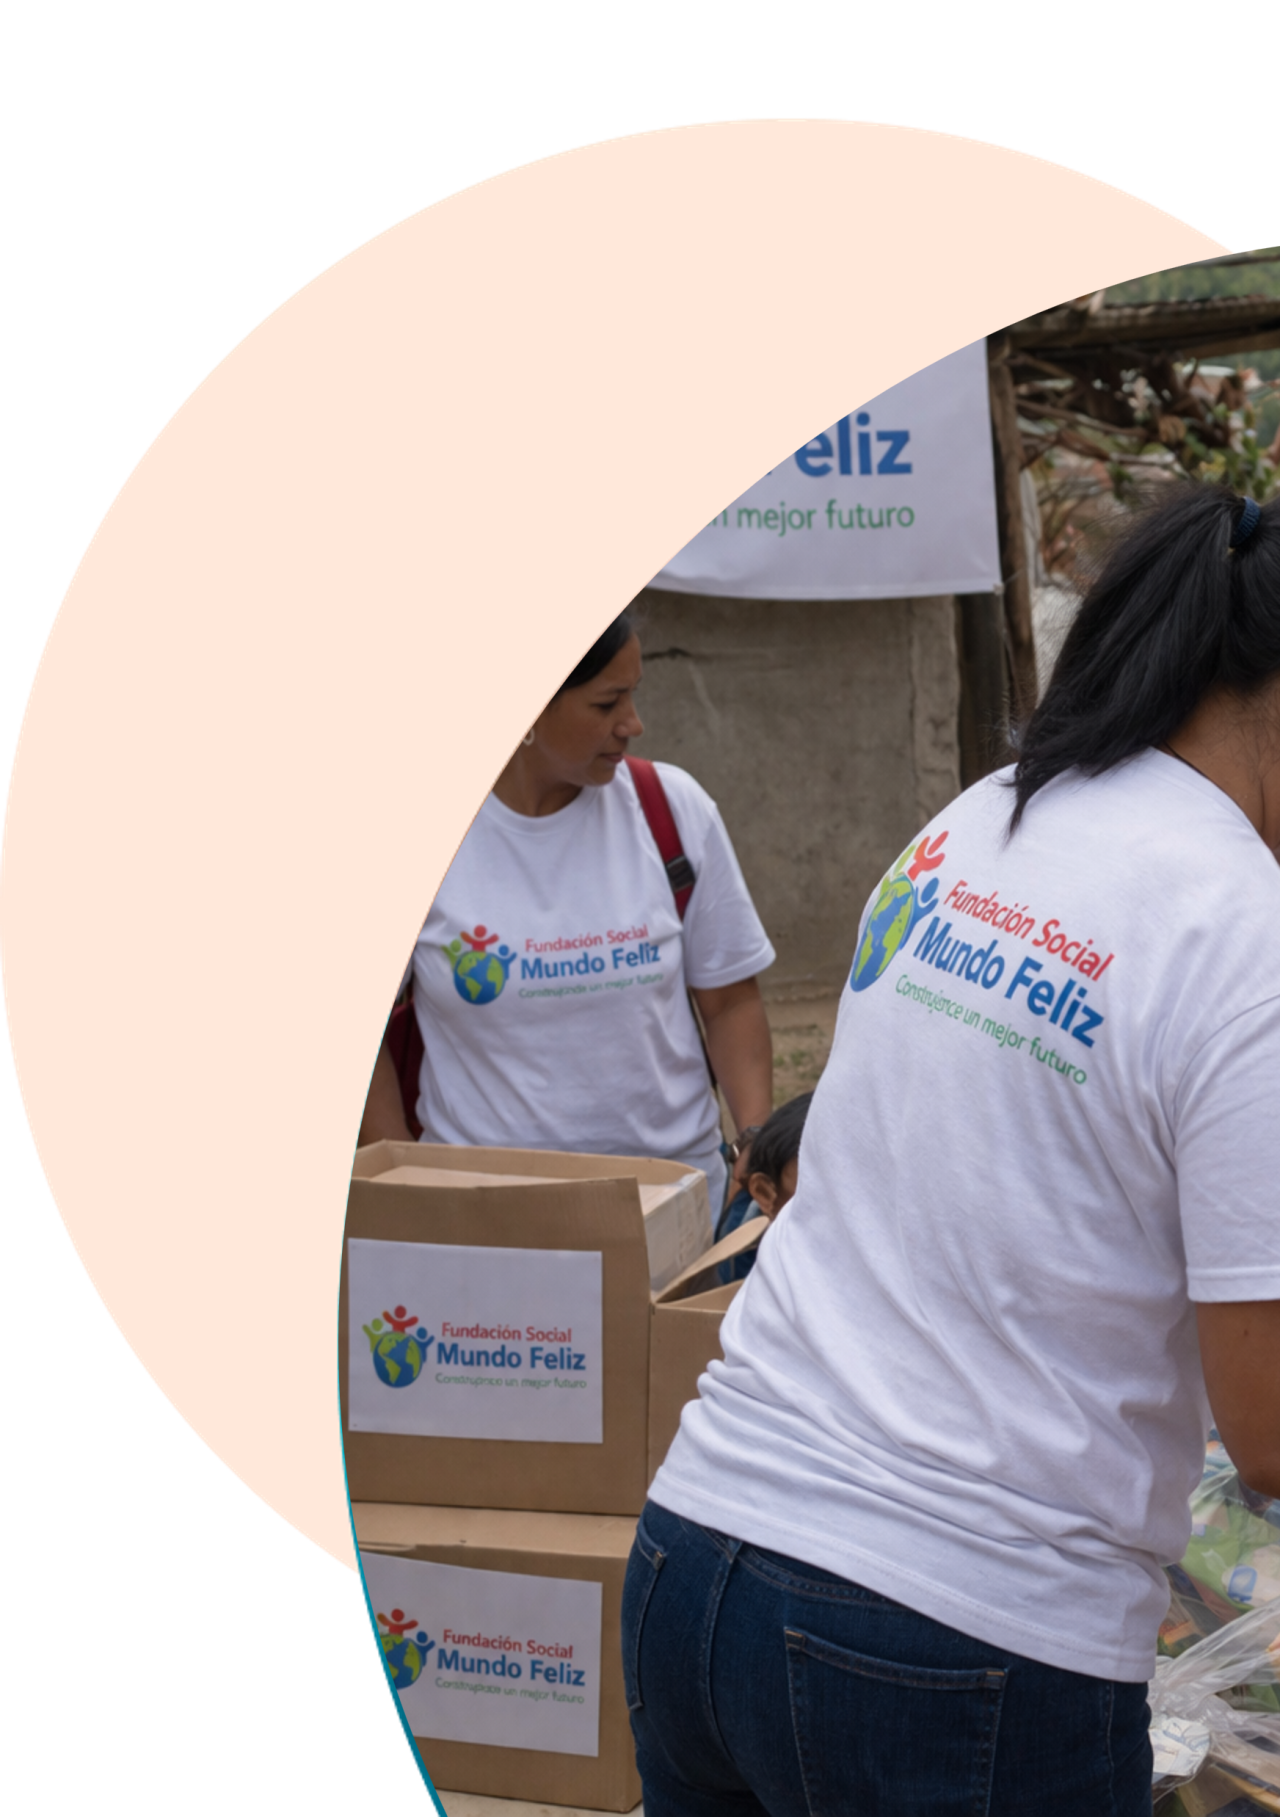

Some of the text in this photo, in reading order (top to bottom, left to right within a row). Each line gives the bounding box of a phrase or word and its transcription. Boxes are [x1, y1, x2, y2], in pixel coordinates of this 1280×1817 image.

[766, 412, 913, 477] eliz
[706, 499, 915, 537] n mejor futuro
[525, 924, 649, 953] Fundación Social
[944, 880, 1115, 982] Fundación Social
[520, 940, 662, 980] Mundo Feliz
[912, 916, 1105, 1050] Mundo Feliz
[962, 1007, 981, 1028] un
[981, 1016, 1028, 1049] mejor
[1029, 1037, 1088, 1085] futuro
[441, 1321, 573, 1343] Fundación Social
[437, 1342, 586, 1371] Mundo Feliz
[442, 1628, 574, 1660] Fundación Social
[437, 1648, 586, 1687] Mundo Feliz
